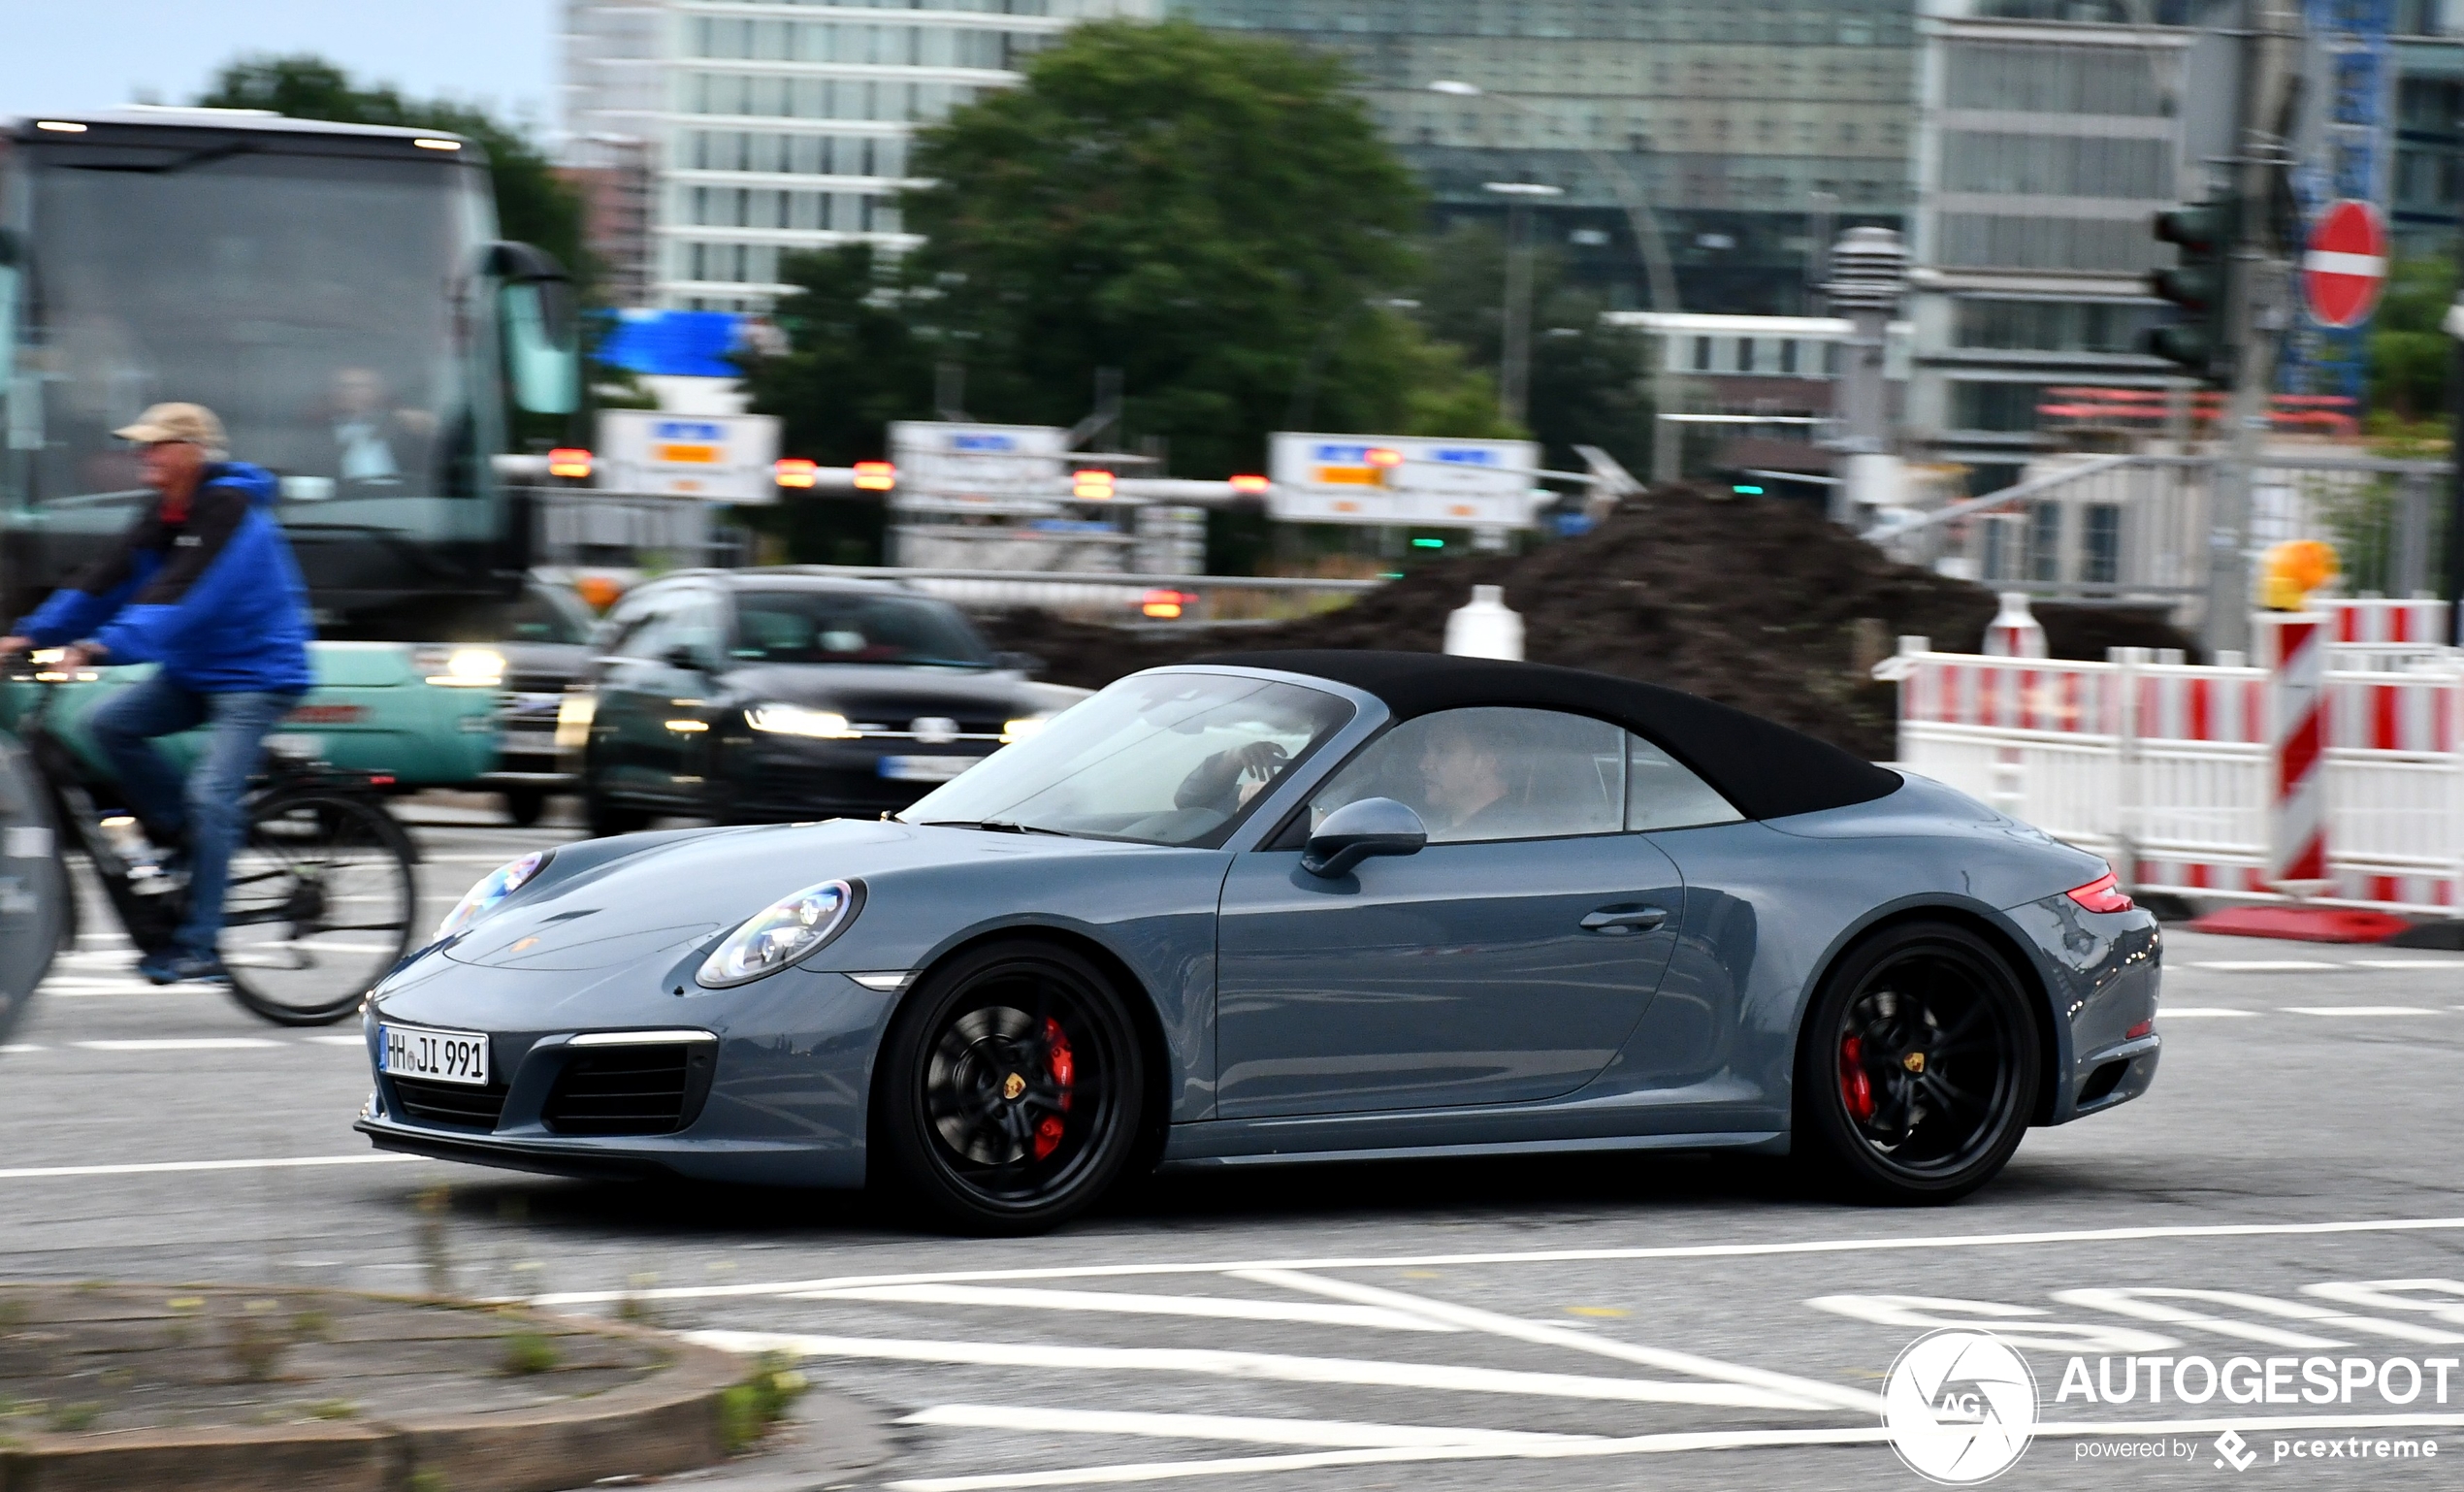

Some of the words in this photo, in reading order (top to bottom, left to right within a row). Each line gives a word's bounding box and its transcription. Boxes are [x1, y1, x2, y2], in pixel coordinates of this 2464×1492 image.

[387, 1032, 405, 1069] HH
[417, 1037, 439, 1074] JI
[445, 1040, 484, 1078] 991
